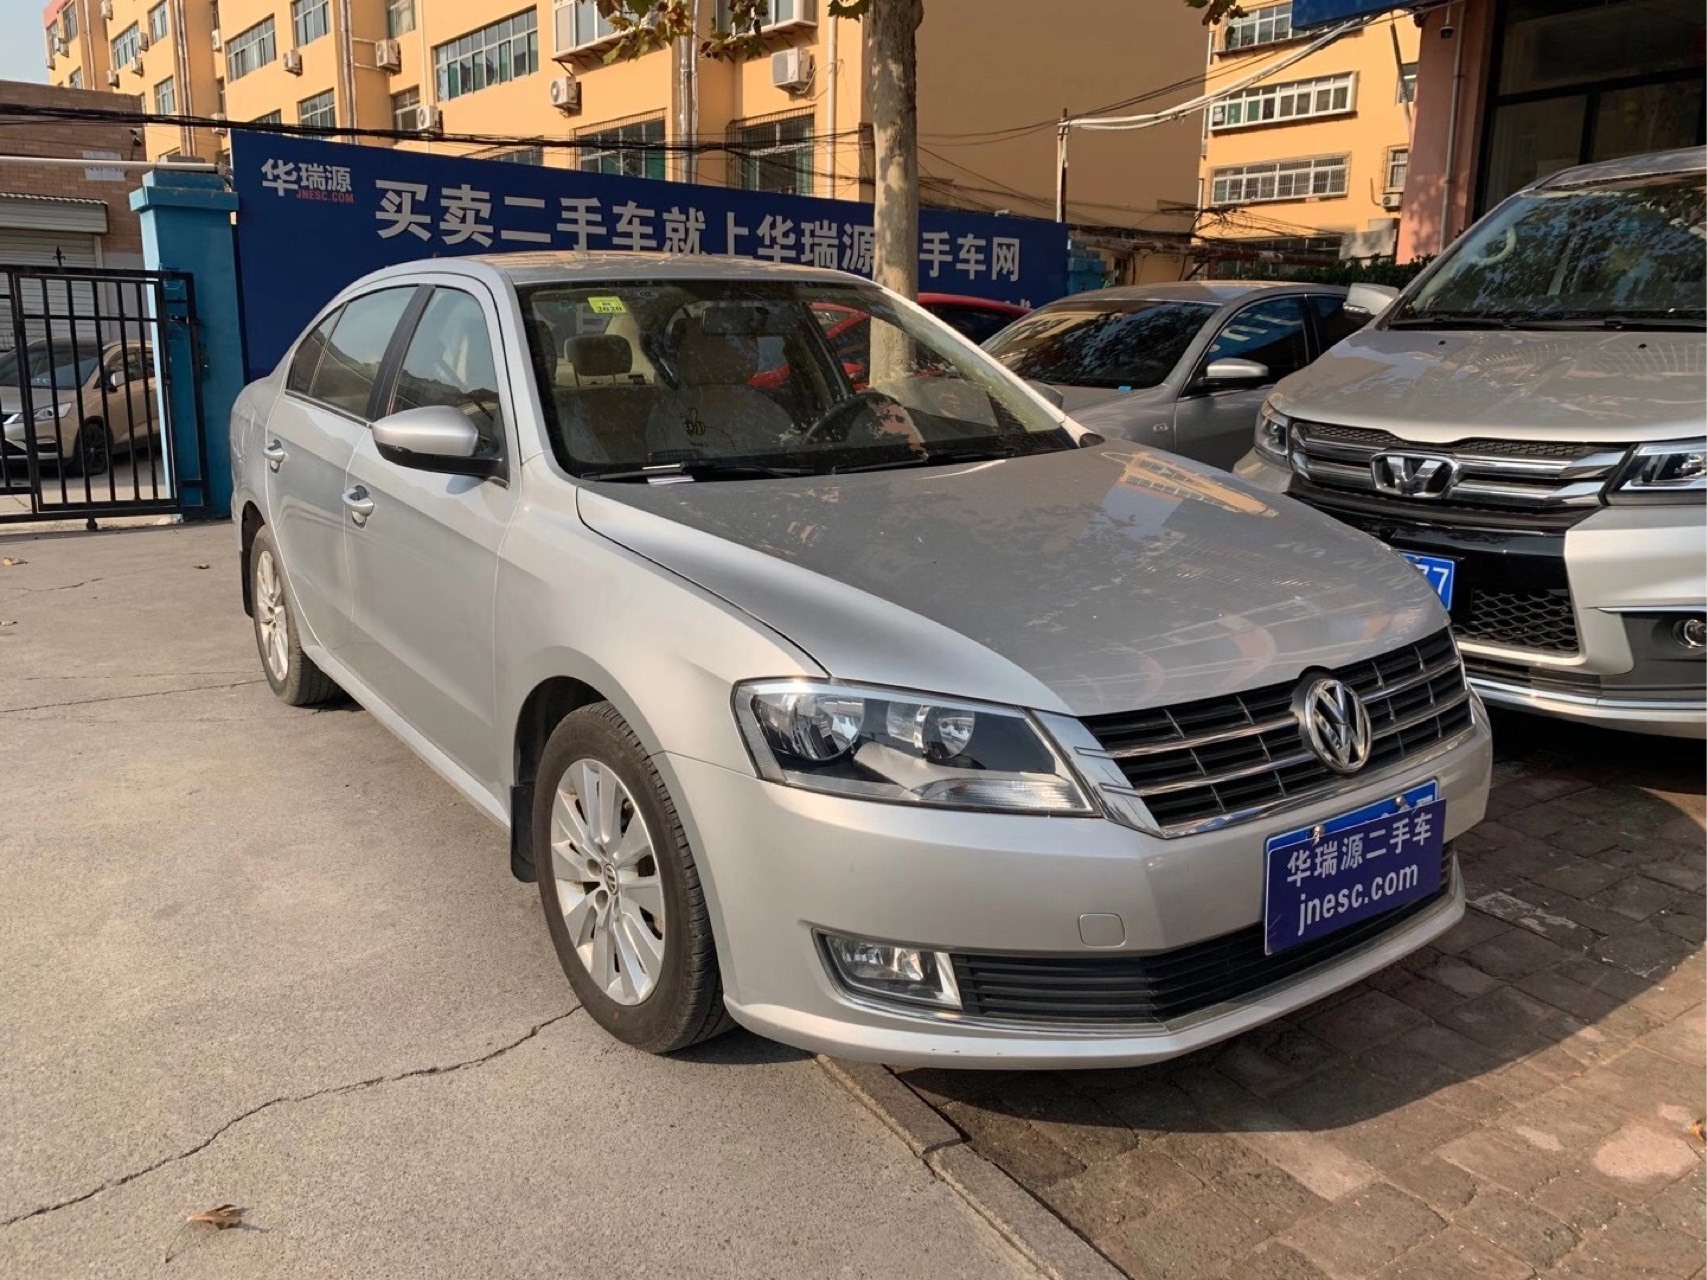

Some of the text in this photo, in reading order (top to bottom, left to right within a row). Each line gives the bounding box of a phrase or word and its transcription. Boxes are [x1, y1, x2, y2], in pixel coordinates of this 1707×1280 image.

[260, 158, 352, 197] 华瑞源
[296, 189, 354, 204] JNESC.COM
[1286, 812, 1433, 887] 华瑞源二手车
[1298, 864, 1418, 936] jnesc.com
